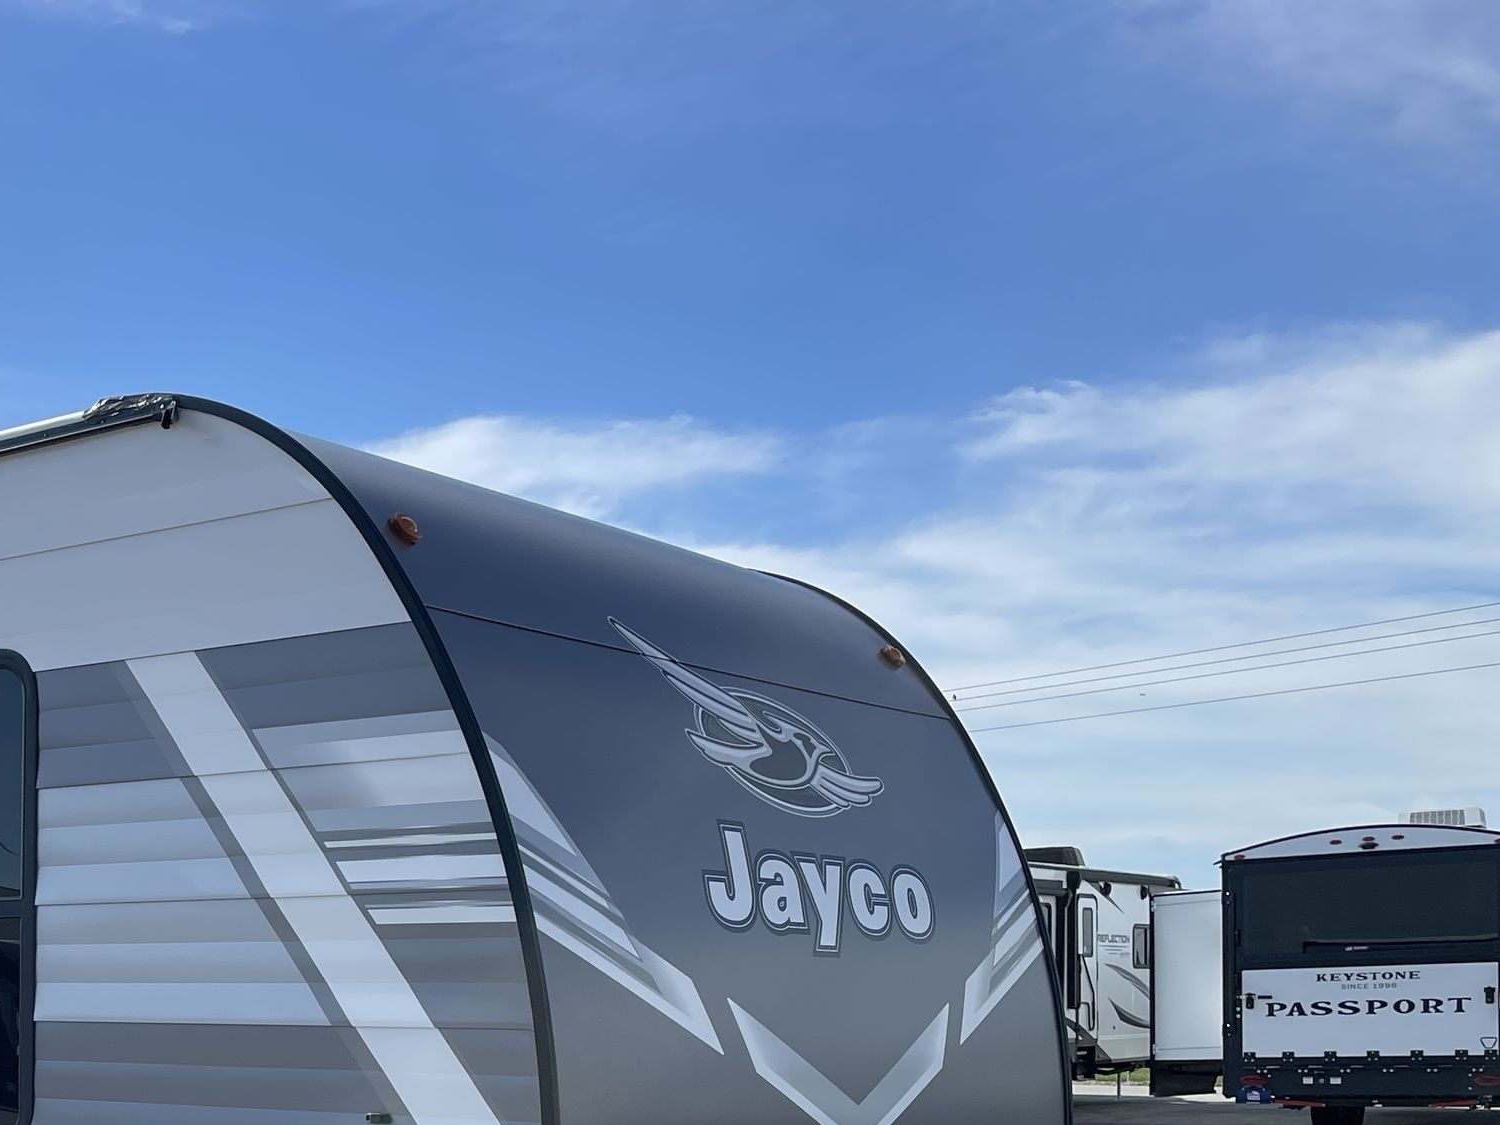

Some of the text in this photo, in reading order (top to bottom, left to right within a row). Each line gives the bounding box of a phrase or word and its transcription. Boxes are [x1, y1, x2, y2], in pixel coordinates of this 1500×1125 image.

[702, 820, 934, 956] Jayco
[1316, 970, 1420, 982] KEYSTONE
[1266, 997, 1472, 1017] PASSPORT
